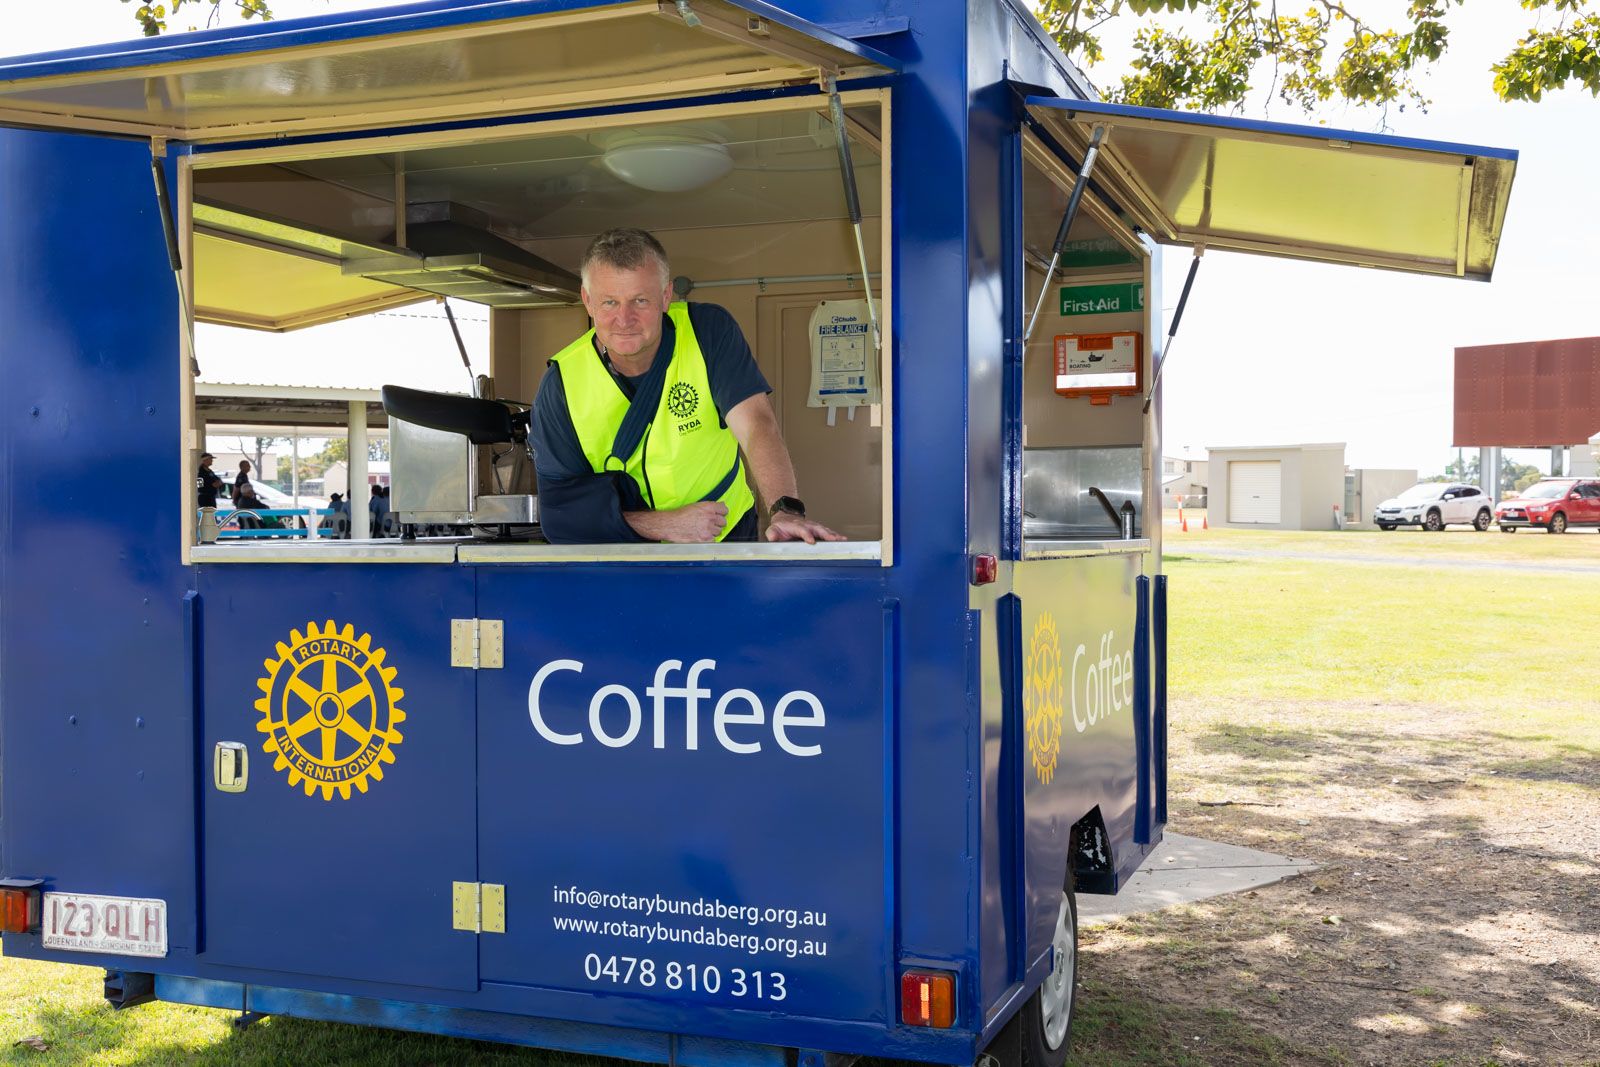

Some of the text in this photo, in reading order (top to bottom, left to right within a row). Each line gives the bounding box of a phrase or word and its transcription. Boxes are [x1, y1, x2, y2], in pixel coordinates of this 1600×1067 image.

[1063, 297, 1120, 313] First Aid
[820, 324, 866, 334] FIRE BLANKET
[678, 419, 701, 432] RYDA
[298, 639, 361, 662] ROTARY
[1071, 630, 1133, 733] Coffee
[528, 658, 826, 757] Coffee
[278, 734, 383, 782] INTERNATIONAL
[51, 900, 160, 942] 123 QLH
[553, 886, 827, 928] info@rotarybundaberg.org.au
[47, 936, 93, 948] QUEENSLAND
[553, 916, 827, 957] www.rotarybundaberg.org.au
[584, 953, 787, 1001] 0478 810 313
